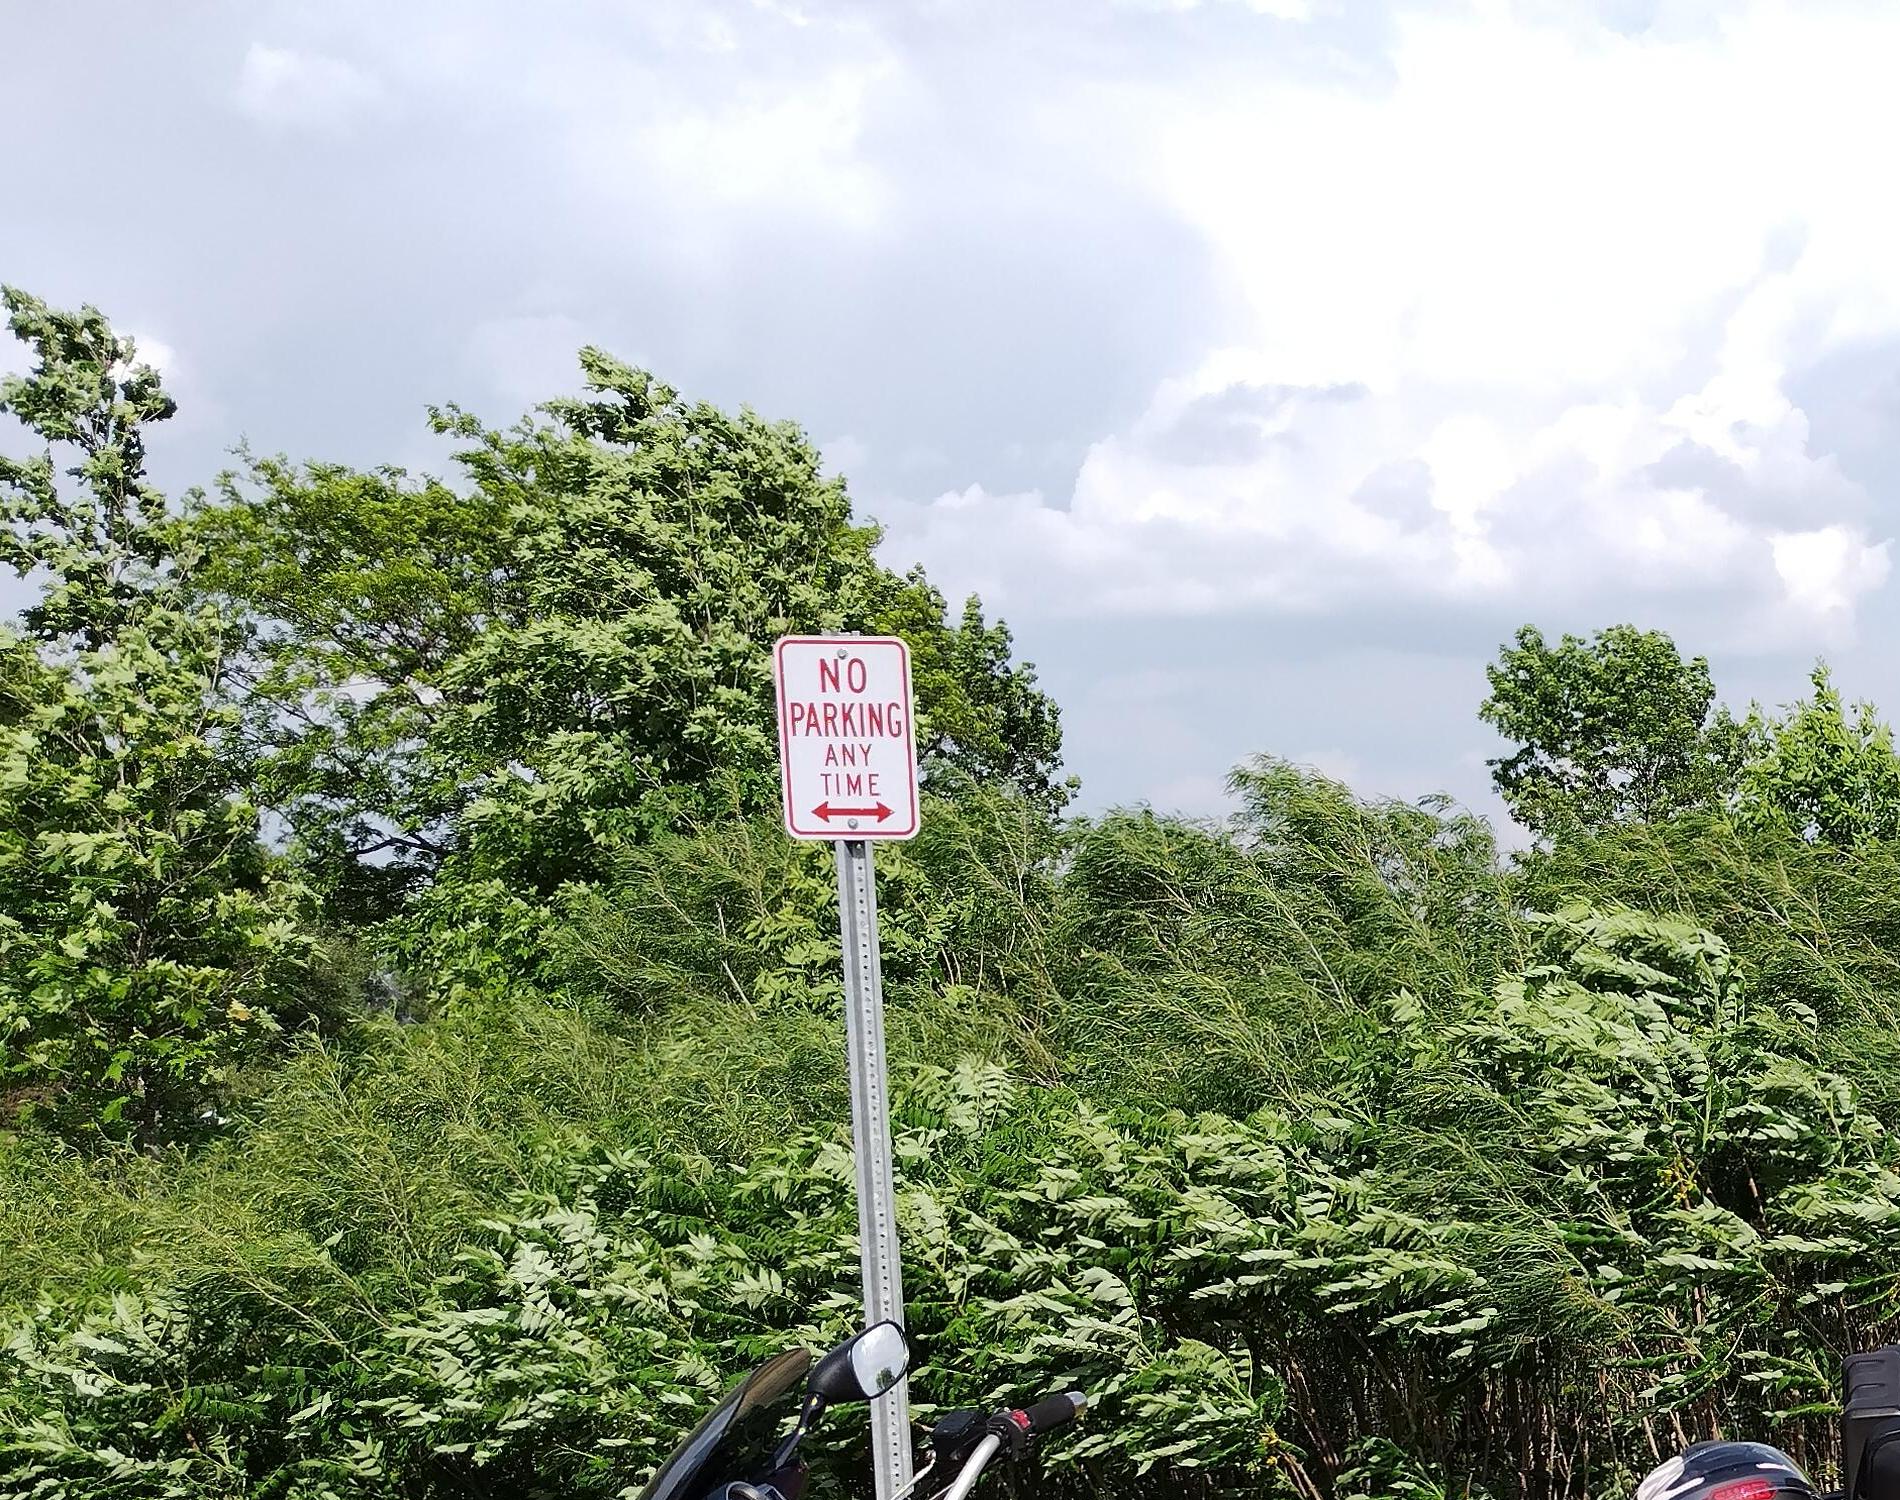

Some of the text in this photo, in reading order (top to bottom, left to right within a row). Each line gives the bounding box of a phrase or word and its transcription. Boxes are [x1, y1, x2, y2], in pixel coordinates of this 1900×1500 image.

[820, 658, 867, 694] NO
[790, 702, 902, 738] PARKING
[825, 744, 872, 767] ANY
[820, 773, 880, 796] TIME
